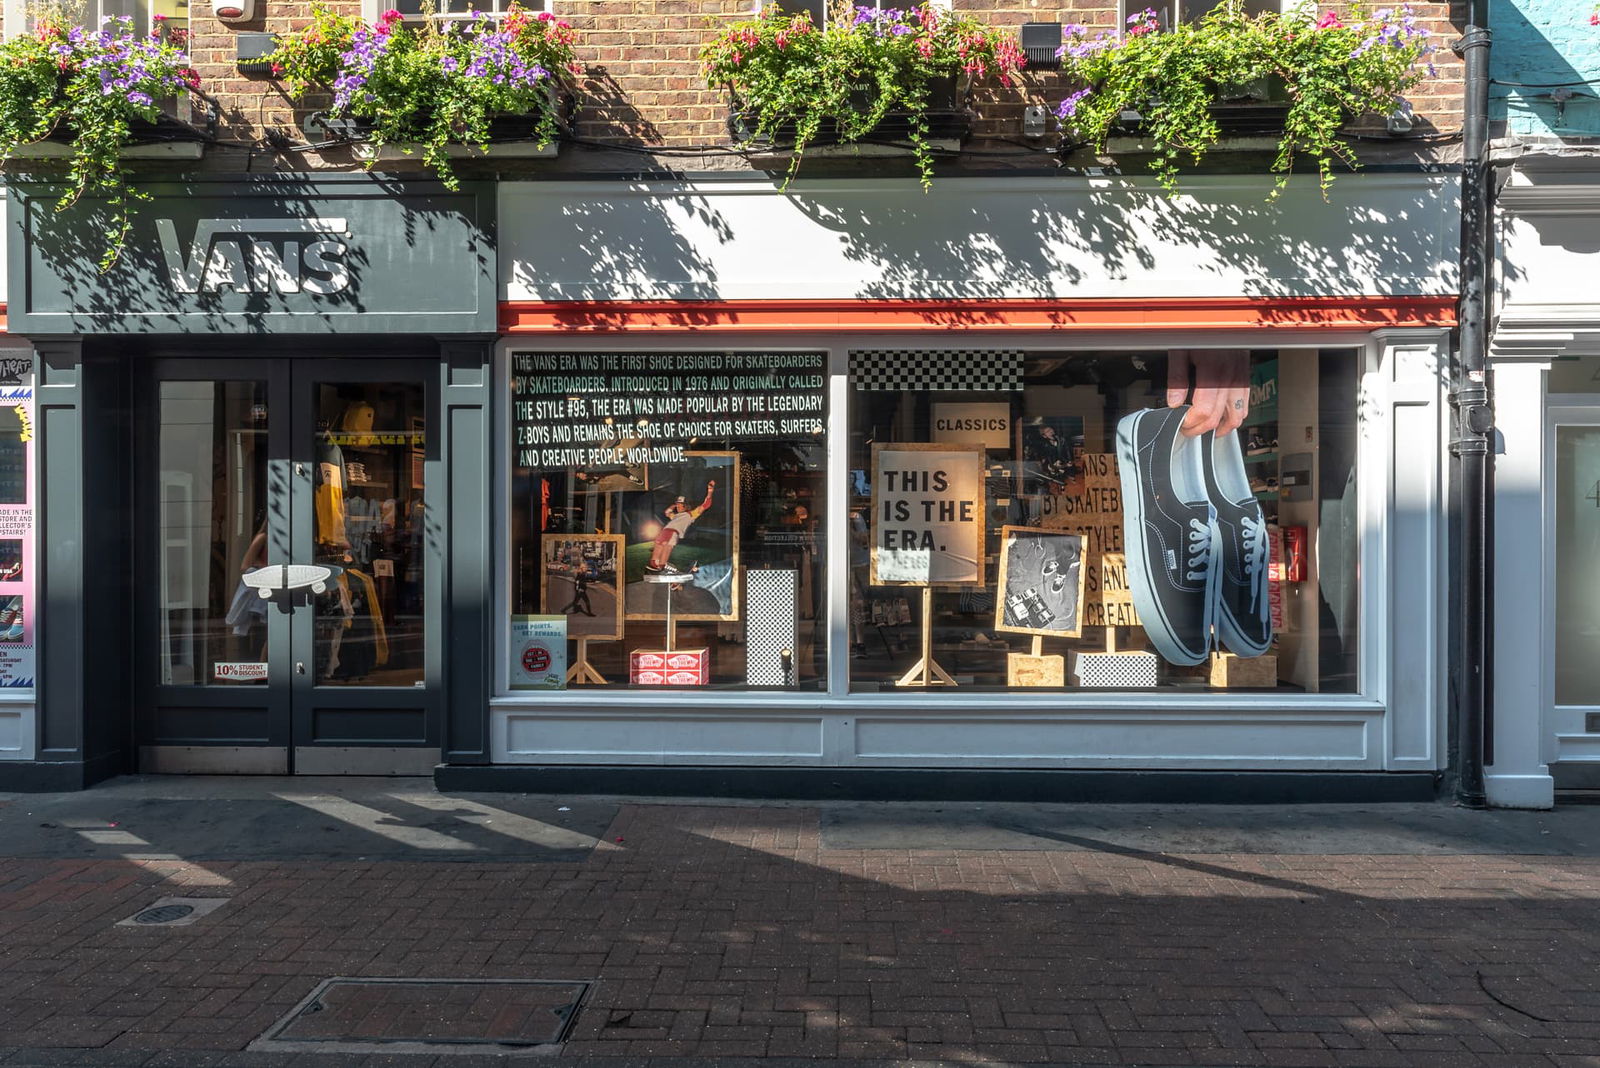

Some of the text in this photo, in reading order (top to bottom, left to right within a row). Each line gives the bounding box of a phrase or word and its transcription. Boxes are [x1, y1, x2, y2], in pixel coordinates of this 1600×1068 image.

[155, 218, 352, 294] VANS
[514, 354, 823, 370] THE VANS ERA WAS THE FIRST SHOE DESIGNED FOR SKATEBOARDERS
[516, 375, 824, 394] BY SKATEBOARDERS. INTRODUCED IN 1976 AND ORIGINALLY CALLED
[515, 395, 823, 420] THE STYLE #95, THE ERA WAS MADE POPULAR BY THE LEGENDARY
[518, 418, 826, 445] Z-BOYS AND REMAINS THE SHOE OF CHOICE FOR SKATERS, SURFERS,
[936, 418, 1007, 431] CLASSICS
[519, 446, 688, 467] AND CREATIVE PEOPLE WORLDWIDE.
[884, 470, 948, 492] THIS
[884, 500, 974, 522] IS THE
[884, 530, 947, 551] ERA.
[216, 664, 238, 675] 10%
